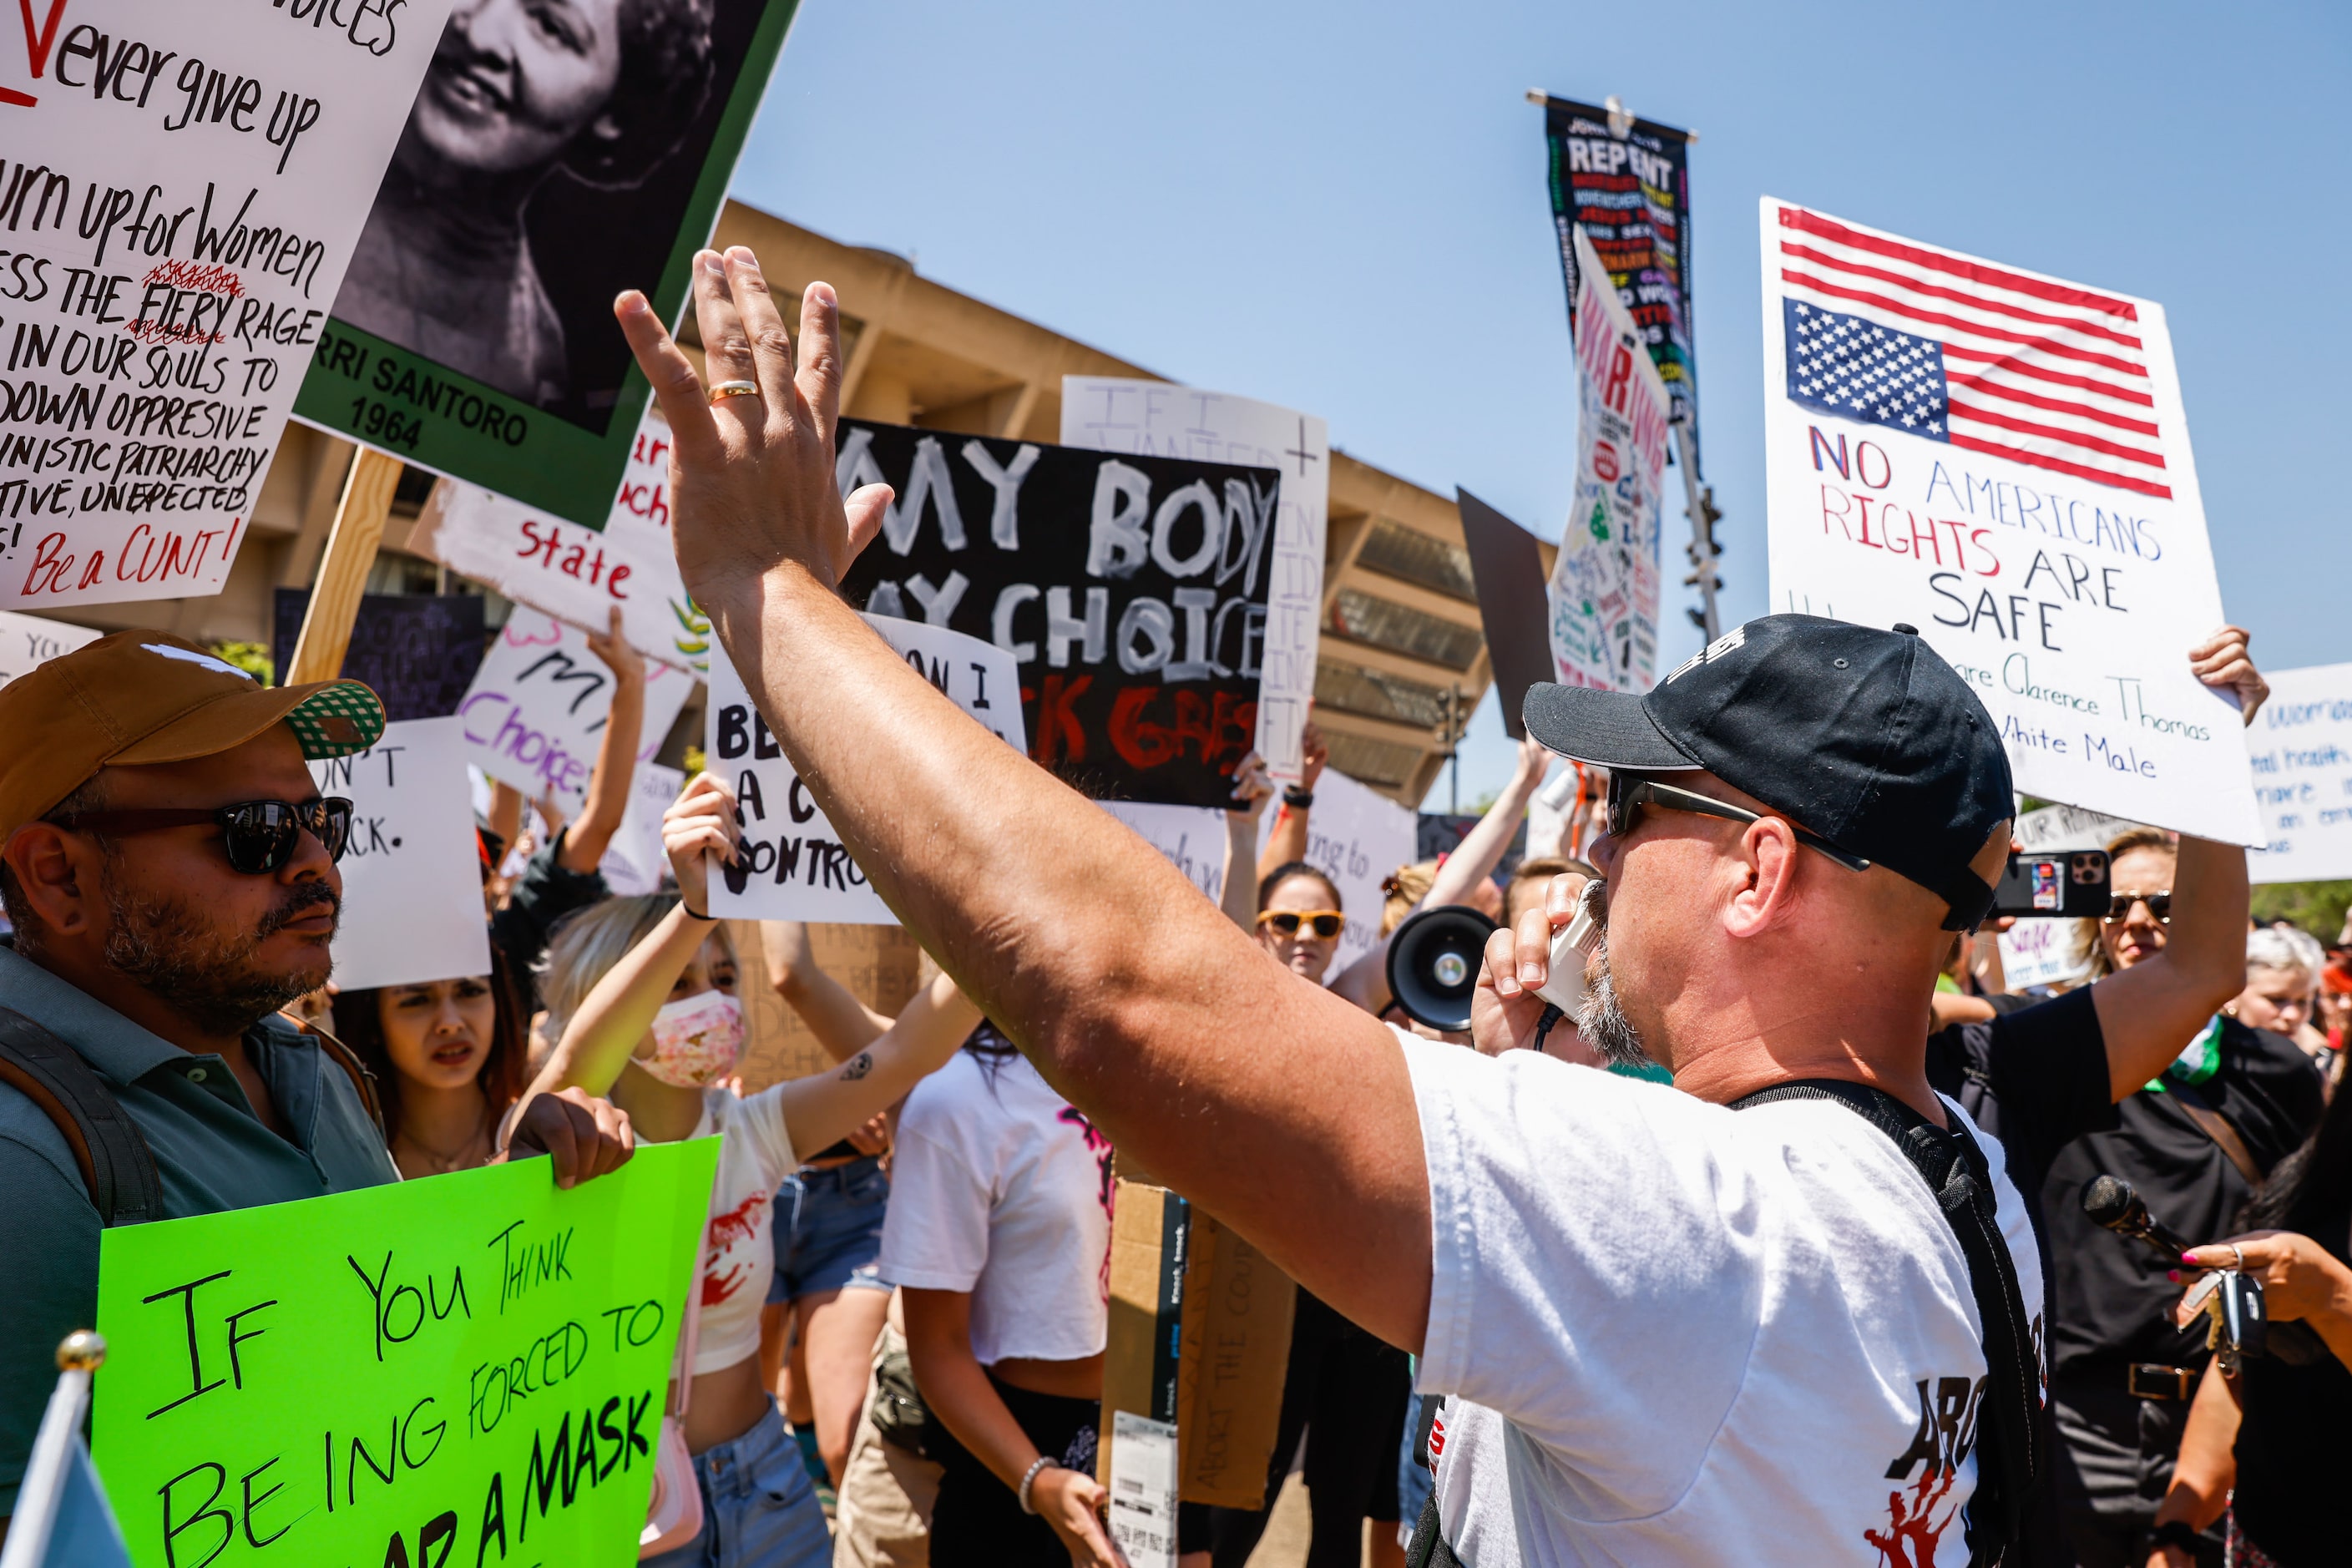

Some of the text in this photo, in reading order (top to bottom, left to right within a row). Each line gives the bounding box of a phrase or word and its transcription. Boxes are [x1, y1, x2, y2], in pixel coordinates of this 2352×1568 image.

[164, 58, 262, 132] give
[266, 90, 321, 175] up
[1566, 136, 1673, 193] REPENT
[78, 182, 134, 267] up
[123, 185, 195, 257] for
[193, 181, 326, 300] Women
[0, 250, 324, 357] SS THE FIERY RAGE
[7, 322, 60, 372] IN
[60, 328, 138, 381] OUR
[139, 345, 229, 394] SOULS
[241, 357, 279, 397] TO
[371, 357, 529, 448] SANTORO
[107, 392, 268, 441] OPPRESIVE
[350, 396, 422, 452] 1964
[111, 441, 270, 487] PATRIARCHY
[619, 481, 669, 527] ch
[1808, 425, 2162, 561] NO AMERICANS
[20, 532, 75, 596] Be
[78, 550, 105, 590] a
[116, 517, 240, 583] CUNT!
[835, 427, 1282, 598] MY BODY
[1820, 483, 2129, 614] RIGHTS ARE
[993, 579, 1267, 683] CHOICE
[1929, 572, 2063, 653] SAFE
[971, 662, 990, 710] I
[2002, 652, 2101, 716] Clarence
[2104, 675, 2212, 742] Thomas
[2084, 732, 2157, 779] Male
[723, 834, 878, 896] CONTRO
[142, 1269, 279, 1420] IF
[346, 1250, 472, 1362] YOU
[468, 1321, 589, 1439] FORCED
[601, 1299, 665, 1353] TO
[519, 1390, 651, 1545] MASK
